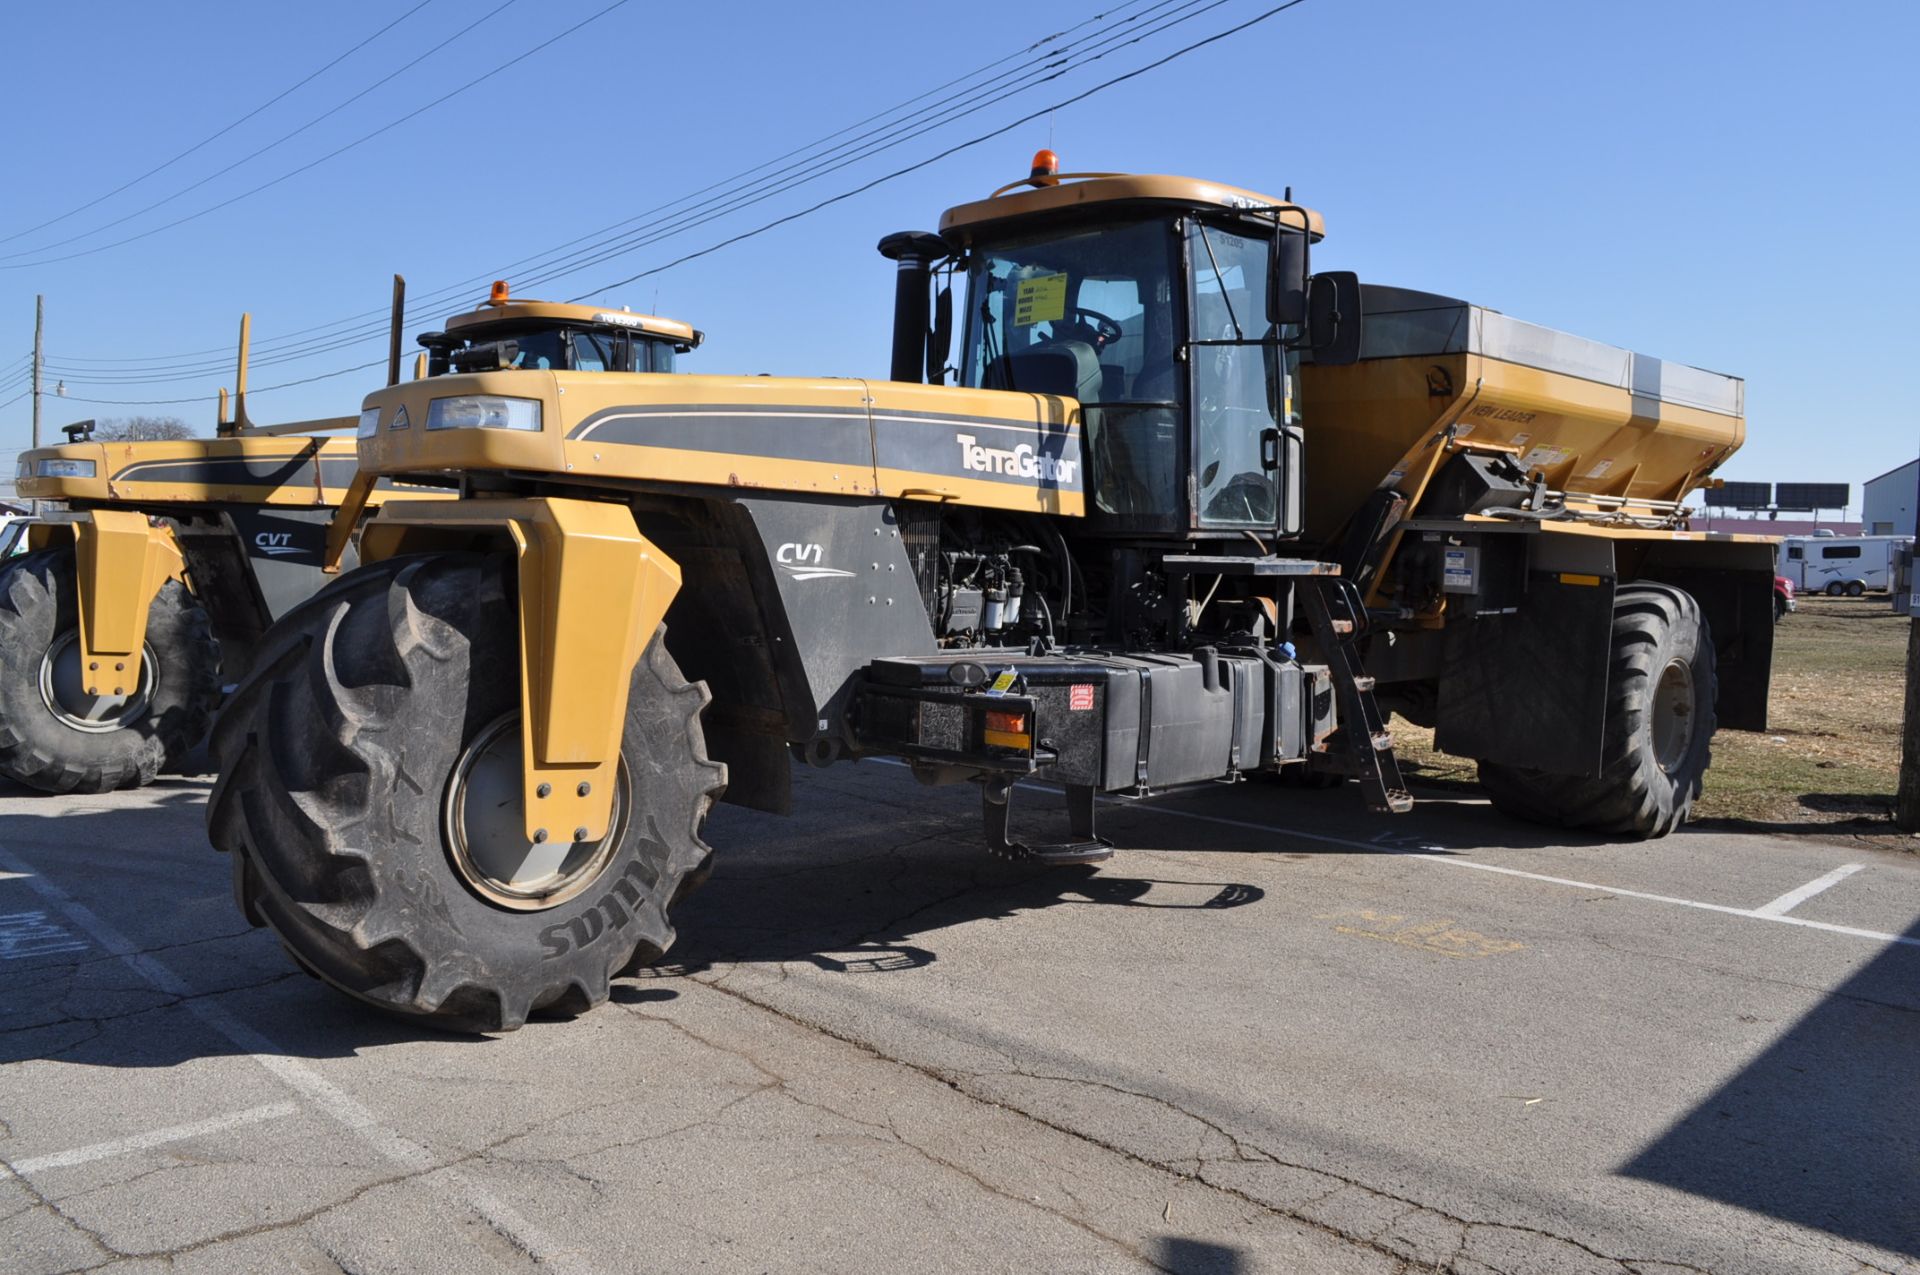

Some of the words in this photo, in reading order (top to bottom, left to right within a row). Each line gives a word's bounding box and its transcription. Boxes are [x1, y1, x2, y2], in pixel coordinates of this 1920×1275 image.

[1471, 405, 1496, 418] NEW
[1493, 408, 1536, 424] LEADER
[956, 433, 1077, 484] TerraGator
[255, 532, 292, 546] CVT
[538, 814, 672, 961] Mitas
